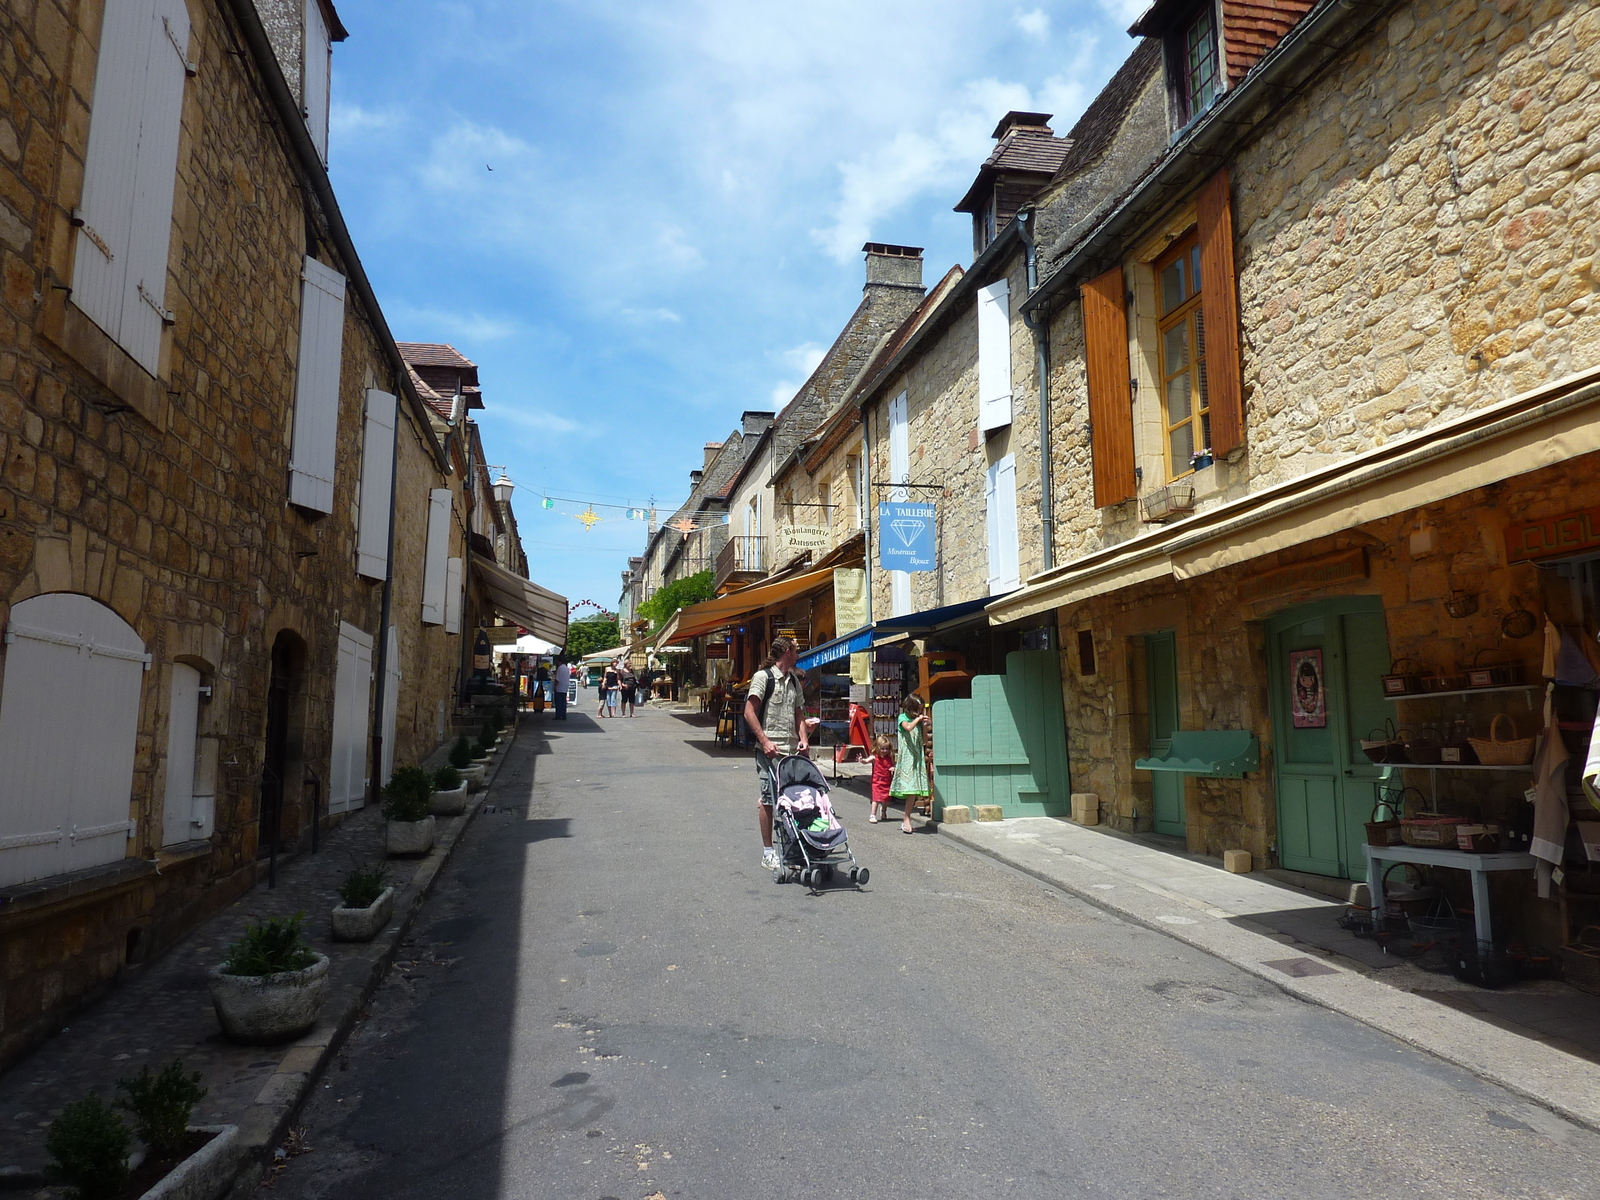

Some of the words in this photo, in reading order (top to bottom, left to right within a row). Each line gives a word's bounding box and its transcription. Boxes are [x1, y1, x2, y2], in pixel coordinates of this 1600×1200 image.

[880, 508, 891, 516] LA
[895, 508, 934, 517] TAILLERIE
[783, 527, 830, 537] Boulangerie
[910, 557, 929, 565] Bijoux
